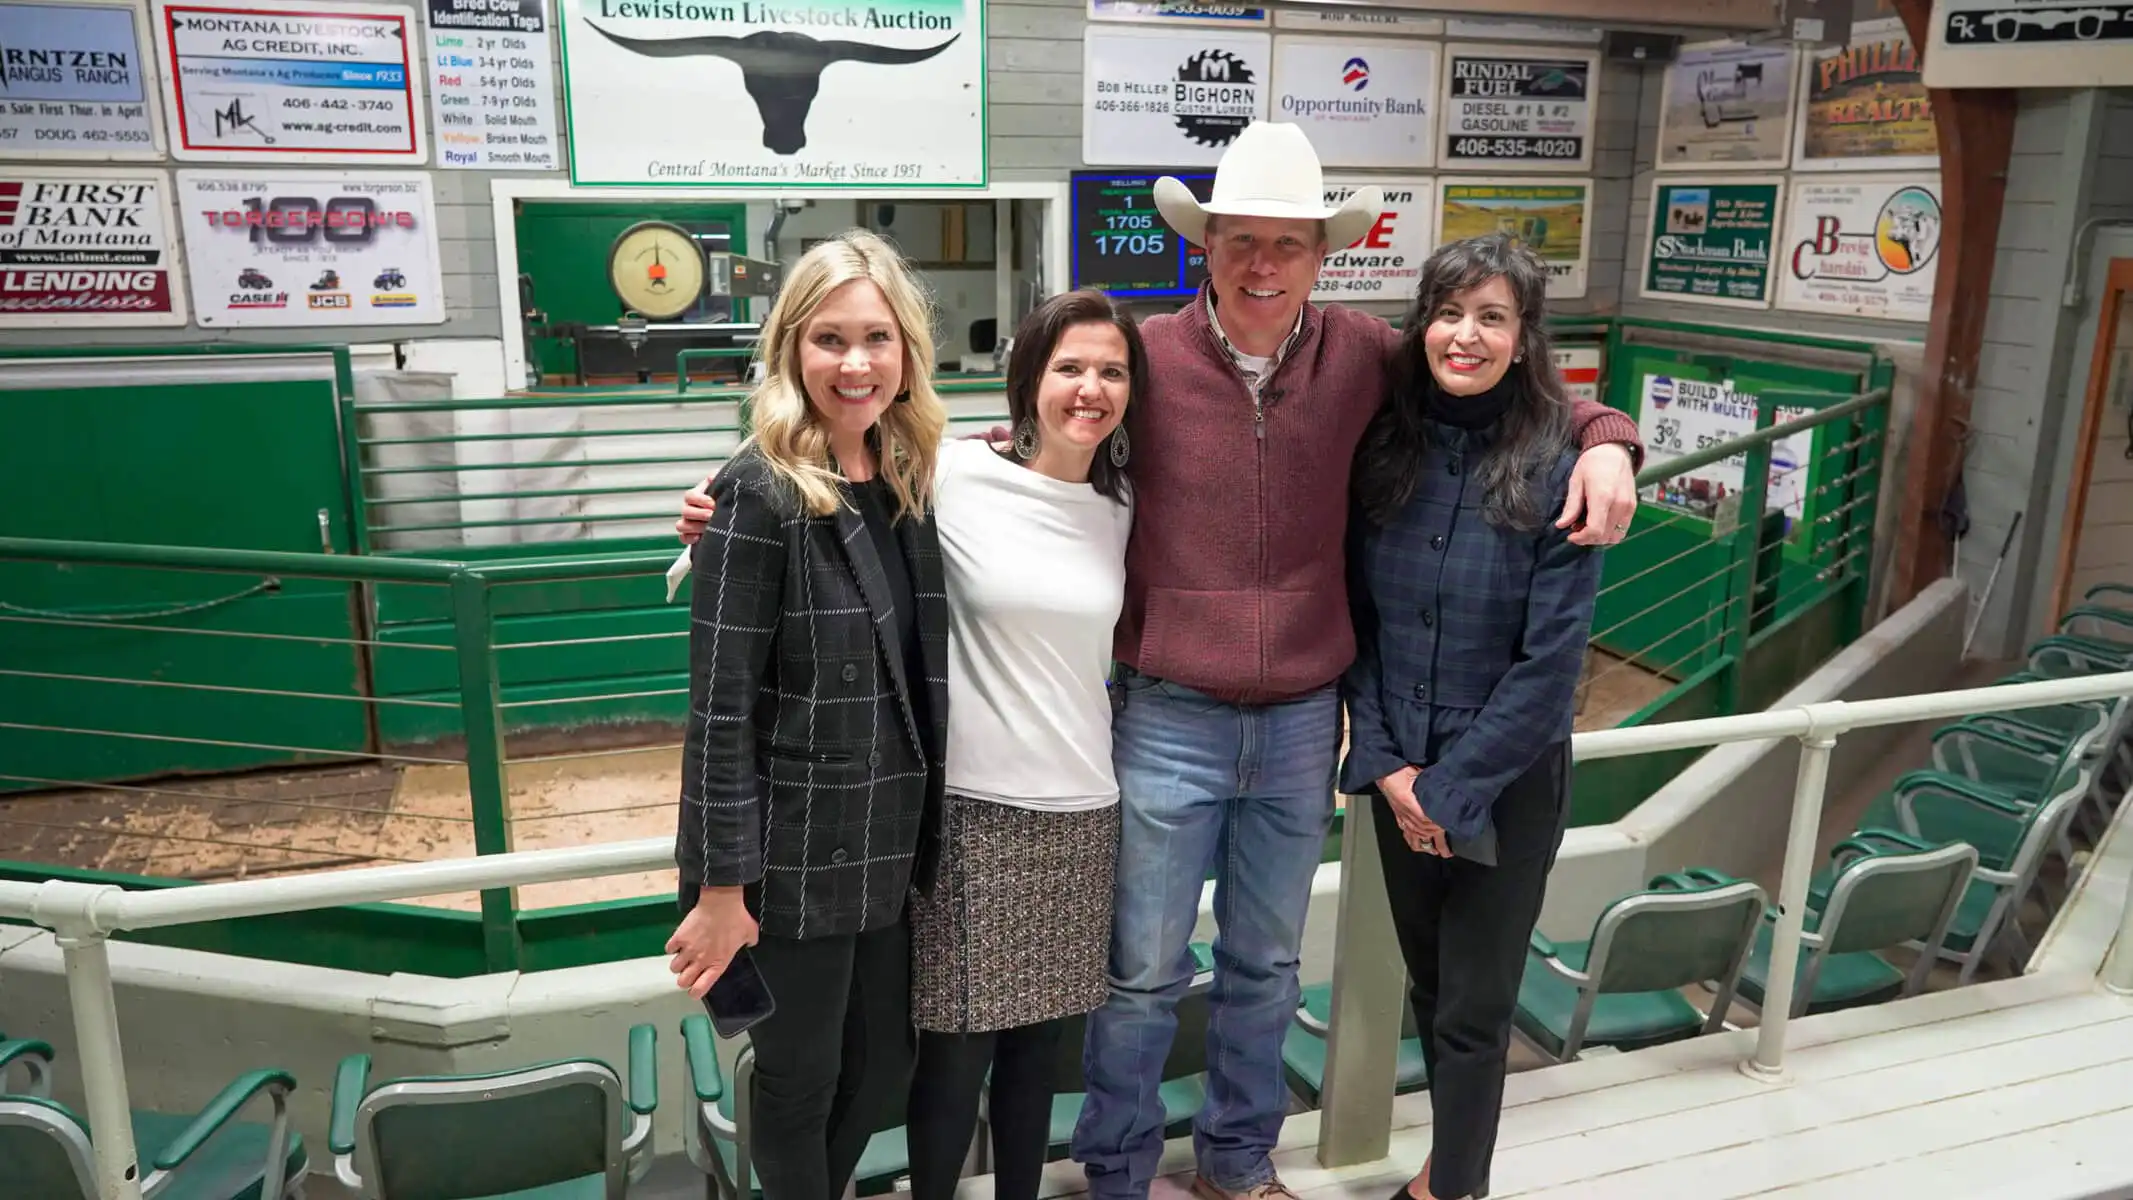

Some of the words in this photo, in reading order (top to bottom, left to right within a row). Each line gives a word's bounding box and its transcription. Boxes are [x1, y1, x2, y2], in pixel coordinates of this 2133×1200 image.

[489, 0, 520, 12] Cow
[434, 11, 510, 27] Identification
[513, 14, 541, 31] Tags
[601, 0, 734, 21] Lewistown
[743, 5, 858, 29] Livestock
[862, 7, 953, 31] Auction
[187, 18, 281, 35] MONTANA
[286, 22, 386, 38] LIVESTOCK
[222, 39, 248, 52] AG
[252, 41, 324, 56] CREDIT,
[327, 43, 364, 56] INC.
[435, 35, 464, 47] Lime
[477, 37, 484, 48] 2
[486, 40, 496, 53] yr
[502, 38, 527, 50] Olds
[182, 65, 220, 78] Serving
[276, 69, 292, 80] Ag
[450, 56, 473, 67] Blue
[479, 56, 496, 69] 3-4
[497, 59, 507, 72] yr
[510, 57, 535, 70] Olds
[1454, 60, 1535, 81] RINDAL
[8, 66, 63, 83] ANGUS
[75, 69, 130, 85] RANCH
[439, 74, 462, 86] Red
[480, 76, 497, 88] 5-6
[499, 79, 509, 91] yr
[511, 77, 536, 89] Olds
[1463, 78, 1523, 97] FUEL
[10, 102, 34, 114] Sale
[39, 103, 64, 116] First
[101, 105, 113, 117] in
[117, 105, 143, 119] April
[440, 94, 470, 106] Green
[500, 97, 510, 109] yr
[512, 95, 537, 108] Olds
[1281, 94, 1381, 116] Opportunity
[1384, 97, 1427, 116] Bank
[1462, 102, 1510, 117] DIESEL
[1514, 104, 1531, 117] #1
[1536, 105, 1545, 118] &
[1551, 105, 1570, 118] #2
[282, 120, 402, 134] www.ag-credit.com
[442, 113, 473, 126] White
[484, 114, 507, 127] Solid
[509, 115, 537, 127] Mouth
[1461, 118, 1530, 132] GASOLINE
[34, 128, 77, 141] DOUG
[486, 133, 518, 145] Broken
[520, 133, 548, 145] Mouth
[1455, 137, 1577, 156] 406-535-4020
[445, 150, 477, 166] Royal
[487, 151, 521, 164] Smooth
[523, 152, 551, 166] Mouth
[646, 158, 706, 178] Central
[710, 161, 789, 179] Montana's
[794, 161, 848, 181] Market
[850, 164, 888, 179] Since
[893, 164, 923, 179] 1951
[32, 183, 154, 204] FIRST
[1123, 195, 1133, 209] 1
[25, 205, 144, 228] BANK
[201, 207, 416, 230] TORGERSON'S
[242, 196, 375, 243] 100
[1105, 215, 1153, 229] 1705
[0, 228, 29, 249] of
[34, 229, 153, 246] Montana
[1094, 234, 1165, 256] 1705
[1732, 237, 1767, 260] Bank
[3, 271, 158, 292] LENDING
[228, 294, 273, 304] CASE
[311, 295, 347, 308] JCB
[1679, 383, 1718, 400] BUILD
[1677, 396, 1709, 412] WITH
[1712, 402, 1757, 421] MULTI
[1653, 424, 1683, 450] 3%
